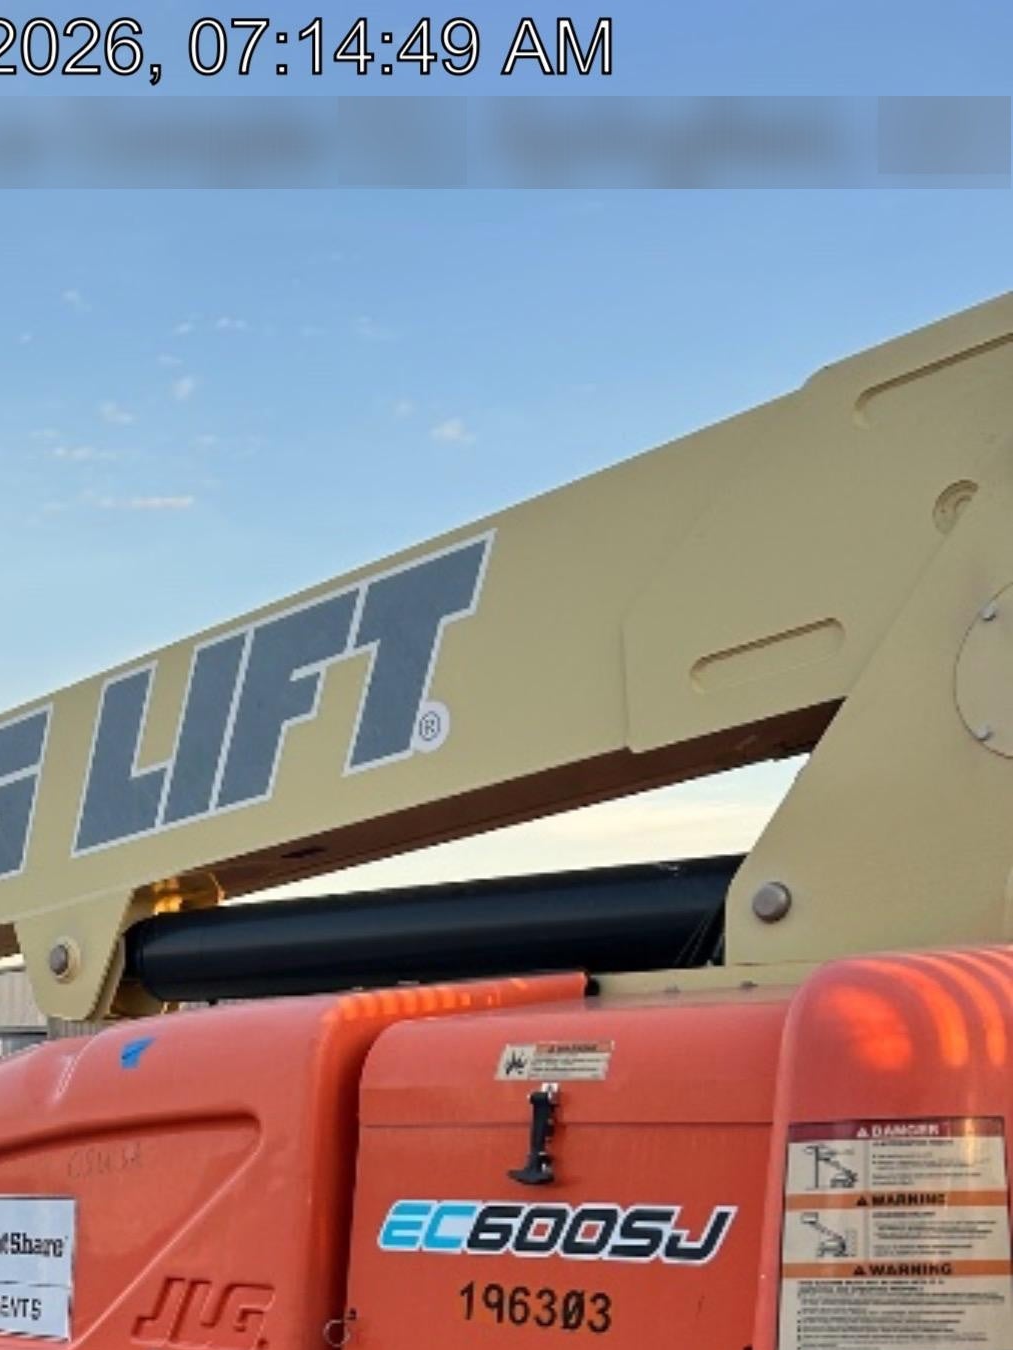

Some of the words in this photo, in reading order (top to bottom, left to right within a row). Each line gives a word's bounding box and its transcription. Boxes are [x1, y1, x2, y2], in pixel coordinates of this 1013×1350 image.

[71, 528, 498, 859] LIFT
[378, 1199, 738, 1264] EC600SJ
[869, 1261, 953, 1276] WARNING
[459, 1280, 613, 1334] 196303
